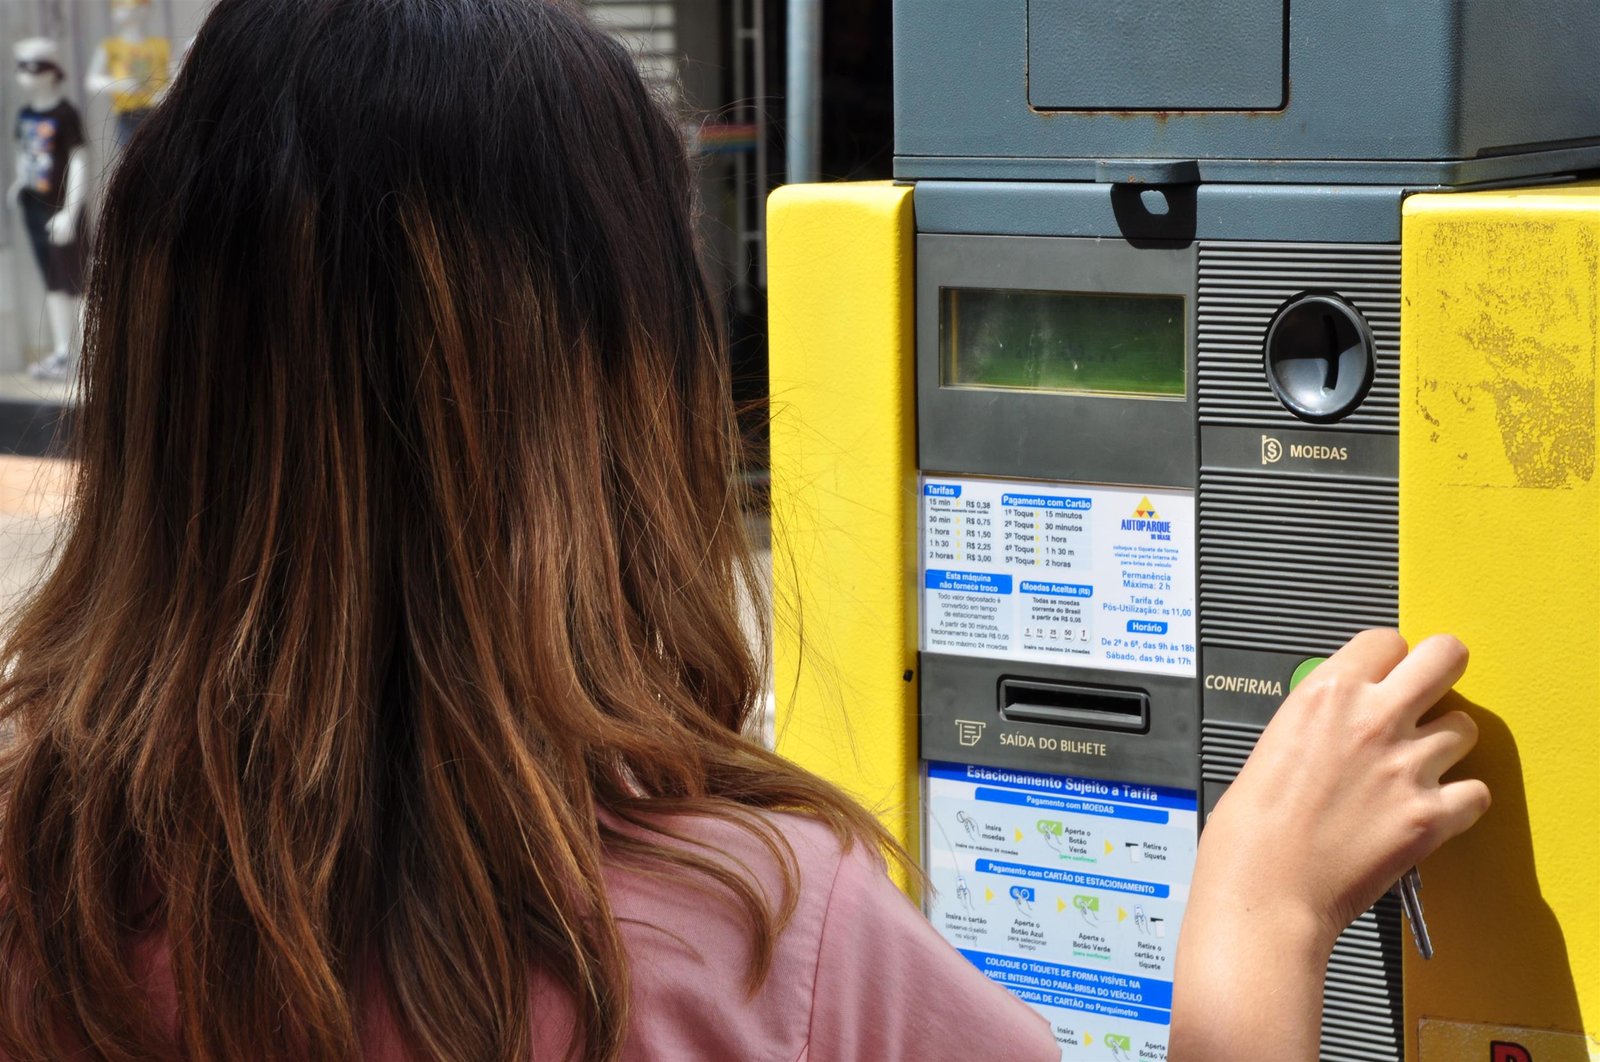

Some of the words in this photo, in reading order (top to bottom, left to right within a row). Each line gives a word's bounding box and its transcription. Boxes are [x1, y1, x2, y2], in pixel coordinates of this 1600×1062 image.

[1290, 444, 1348, 461] MOEDAS
[928, 485, 955, 495] Tarifas
[966, 500, 975, 509] R$
[977, 501, 991, 509] 0,38
[1003, 495, 1046, 506] Pagamento
[1065, 499, 1091, 508] Cartão
[1014, 510, 1034, 518] Toque
[1055, 511, 1083, 519] minutos
[966, 517, 975, 525] R$
[977, 518, 991, 526] 0,75
[1014, 521, 1034, 530] Toque
[1055, 524, 1083, 532] minutos
[1121, 519, 1171, 534] AUTOPARQUE
[935, 528, 950, 536] hora
[966, 530, 975, 538] R$
[977, 531, 991, 539] 1,50
[1014, 533, 1034, 542] Toque
[941, 540, 949, 548] 30
[966, 542, 975, 550] R$
[977, 543, 992, 551] 2,25
[1015, 545, 1034, 554] Toque
[935, 552, 954, 560] horas
[967, 553, 975, 561] R$
[977, 554, 992, 562] 3,00
[1015, 557, 1035, 566] Toque
[1052, 560, 1071, 568] horas
[946, 572, 961, 580] Esta
[962, 574, 992, 583] máquina
[1122, 570, 1171, 581] Permanência
[940, 581, 952, 589] não
[953, 583, 979, 591] fornece
[980, 584, 998, 592] troco
[1022, 582, 1050, 592] Moedas
[1051, 585, 1077, 594] Aceitas
[1078, 588, 1091, 596] (R$)
[1123, 579, 1156, 589] Máxima:
[1130, 596, 1152, 605] Tarifa
[1103, 603, 1160, 616] Pós-Utilização:
[1172, 608, 1192, 617] 11,00
[1132, 622, 1162, 632] Horário
[1101, 637, 1112, 646] De
[1158, 642, 1168, 650] 9h
[1170, 643, 1179, 651] às
[1181, 644, 1195, 652] 18h
[1106, 651, 1137, 662] Sábado,
[1139, 654, 1153, 662] das
[1155, 655, 1164, 663] 9h
[1166, 656, 1175, 664] às
[1178, 657, 1191, 665] 17h
[1205, 675, 1282, 696] CONFIRMA
[1000, 731, 1035, 748] SAÍDA
[1039, 737, 1057, 750] DO
[1061, 740, 1107, 756] BILHETE
[967, 765, 1062, 789] Estacionamento
[1065, 778, 1109, 795] Sujeito
[1111, 786, 1119, 796] a
[1122, 785, 1158, 801] Tarifa
[1026, 795, 1065, 807] Pagamento
[1066, 802, 1081, 810] com
[1082, 803, 1114, 814] MOEDAS
[985, 824, 1002, 832] Insira
[1064, 827, 1085, 836] Aperte
[982, 833, 1005, 842] moedas
[1068, 837, 1087, 845] Botão
[1069, 846, 1087, 854] Verde
[1143, 842, 1162, 851] Retire
[988, 863, 1027, 876] Pagamento
[1028, 869, 1042, 877] com
[1044, 871, 1074, 882] CARTÃO
[1075, 875, 1085, 883] DE
[1086, 876, 1155, 894] ESTACIONAMENTO
[1014, 919, 1034, 928] Aperte
[1011, 927, 1029, 936] Botão
[1030, 929, 1044, 938] Azul
[1079, 932, 1099, 942] Aperte
[1073, 941, 1091, 950] Botão
[1093, 943, 1111, 952] Verde
[1137, 941, 1156, 950] Retire
[1134, 951, 1154, 960] cartão
[985, 957, 1020, 969] COLOQUE
[1021, 962, 1028, 971] O
[1030, 963, 1059, 976] TÍQUETE
[1061, 969, 1071, 978] DE
[1072, 971, 1099, 982] FORMA
[1100, 975, 1128, 987] VISÍVEL
[1129, 980, 1141, 989] NA
[984, 969, 1007, 980] PARTE
[1008, 973, 1039, 985] INTERNA
[1040, 979, 1052, 988] DO
[1053, 980, 1096, 995] PARA-BRISA
[1097, 987, 1109, 996] DO
[1110, 988, 1142, 1002] VEÍCULO
[1042, 995, 1053, 1003] DE
[1053, 996, 1084, 1008] CARTÃO
[1096, 1003, 1138, 1017] Parquímetro
